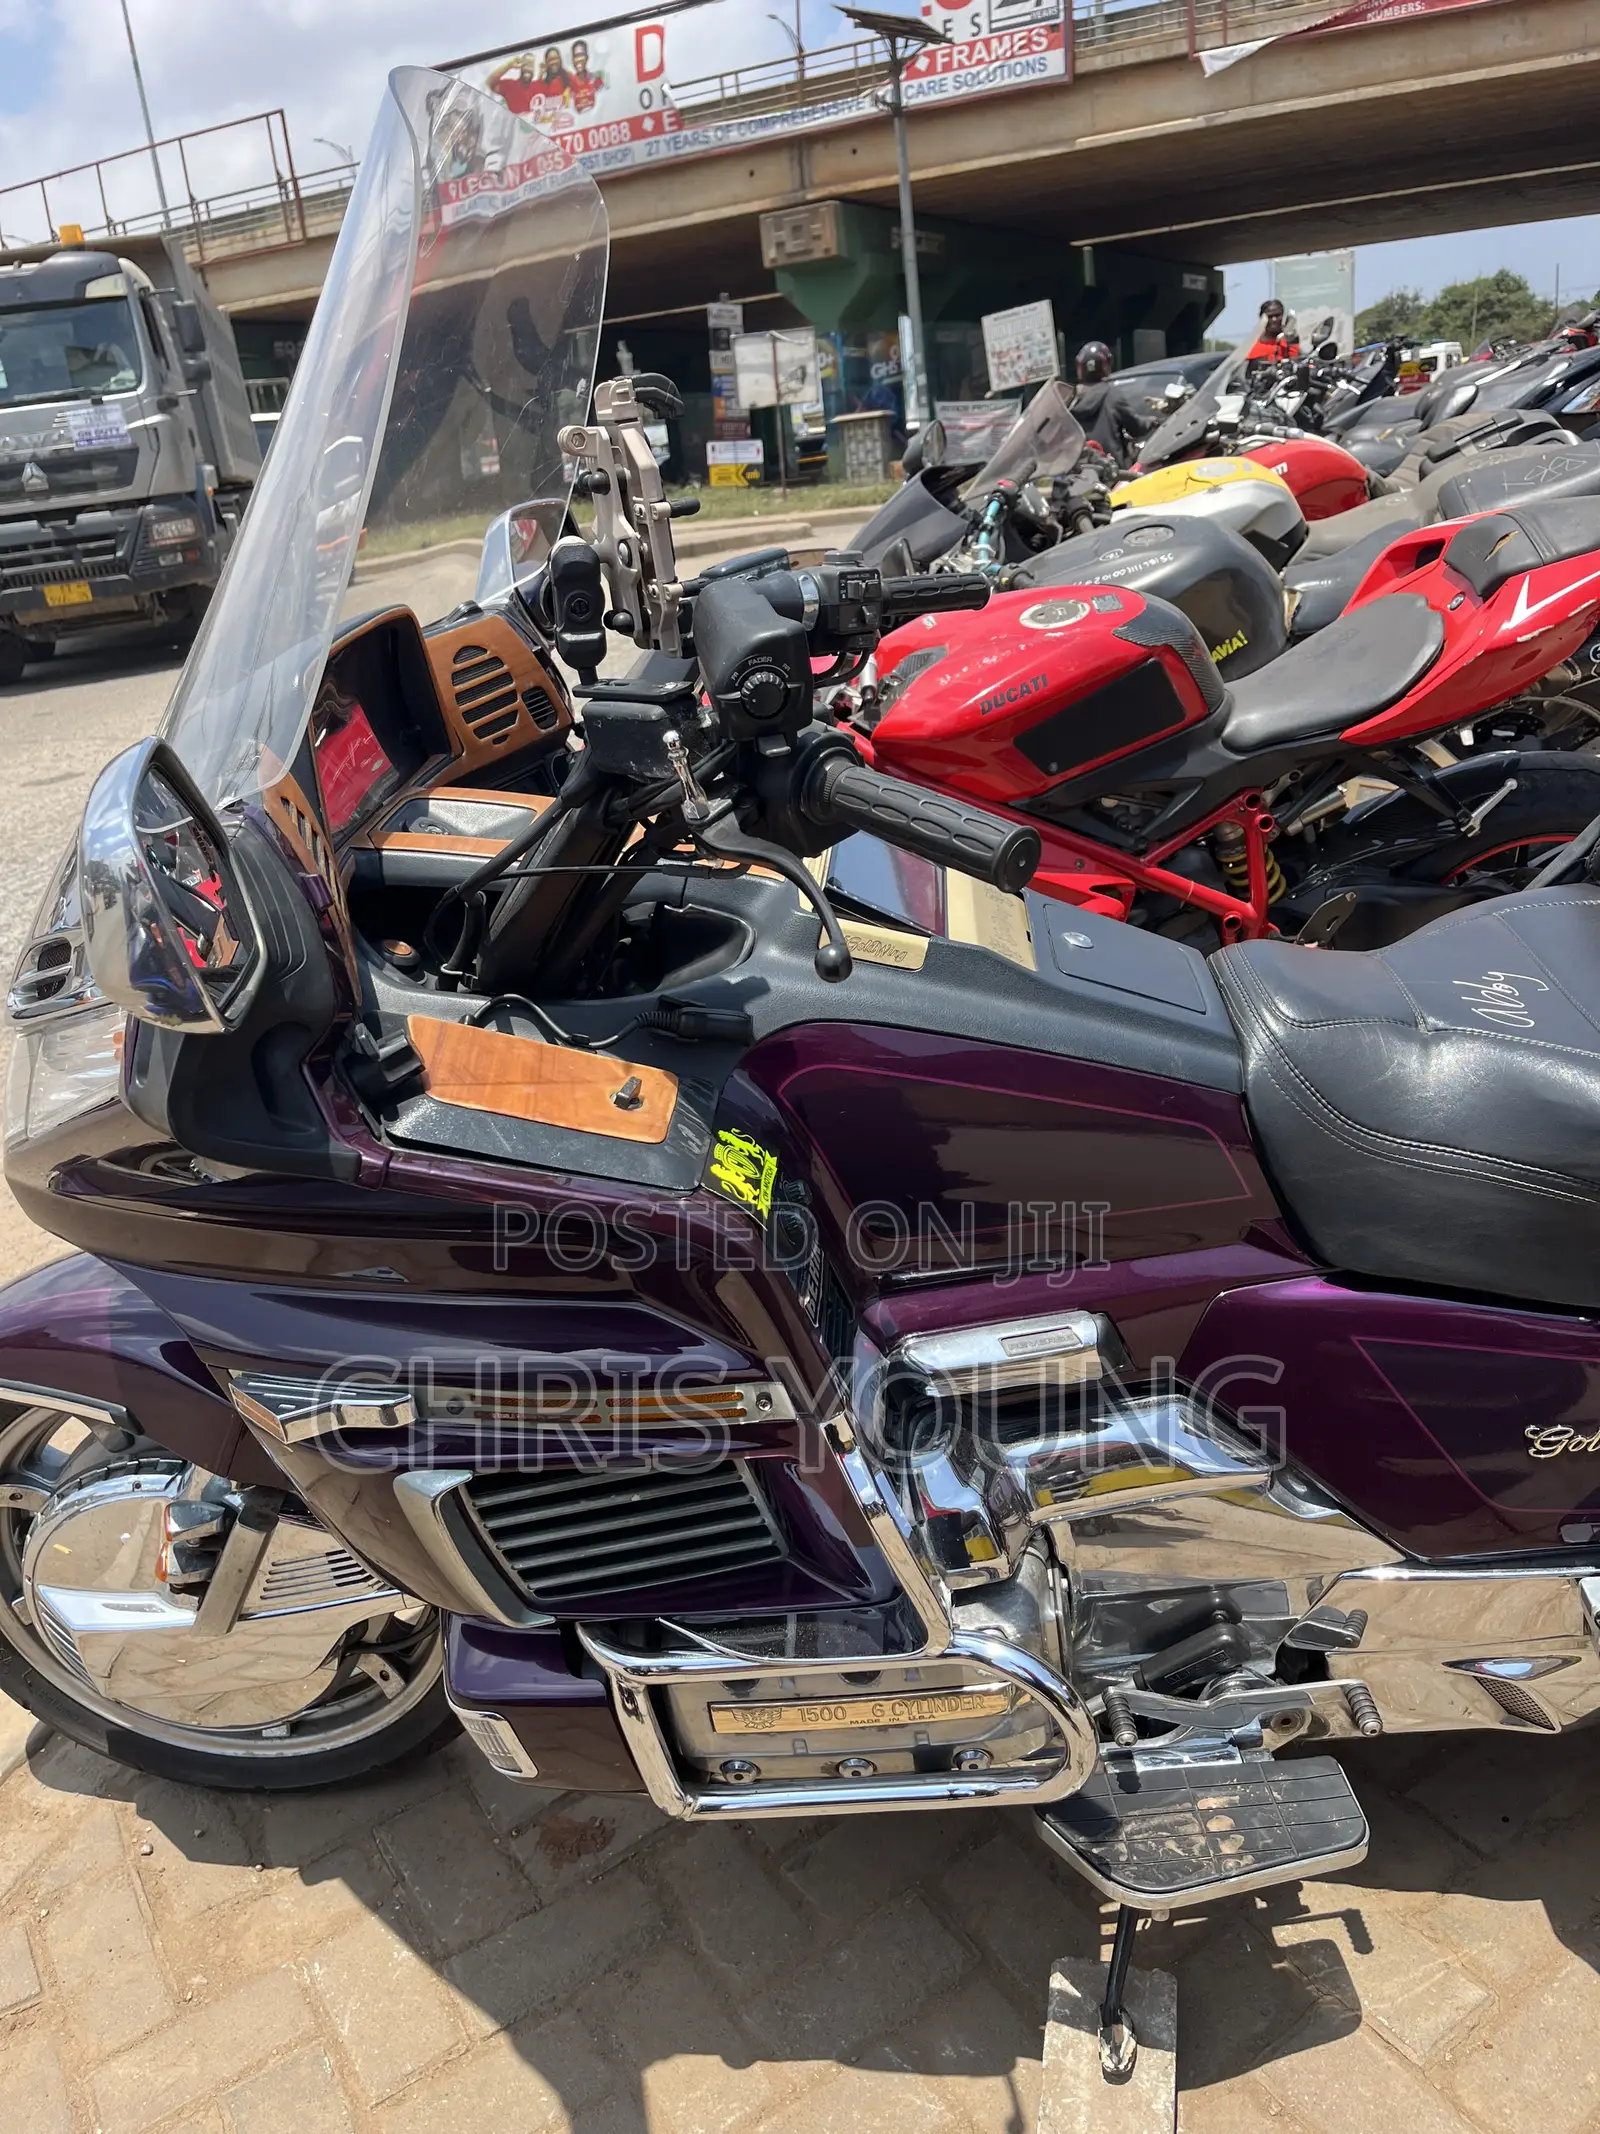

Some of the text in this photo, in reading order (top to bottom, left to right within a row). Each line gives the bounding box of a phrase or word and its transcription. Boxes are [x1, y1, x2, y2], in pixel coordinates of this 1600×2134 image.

[936, 28, 1049, 73] FRAMES
[663, 131, 710, 153] YEARS
[904, 77, 949, 101] CARE
[952, 57, 1048, 90] SOLUTIONS
[588, 121, 632, 147] 0088
[747, 656, 773, 666] FADER
[980, 673, 1048, 716] DUCATI
[797, 1693, 987, 1723] 1500 6 CYLINDER
